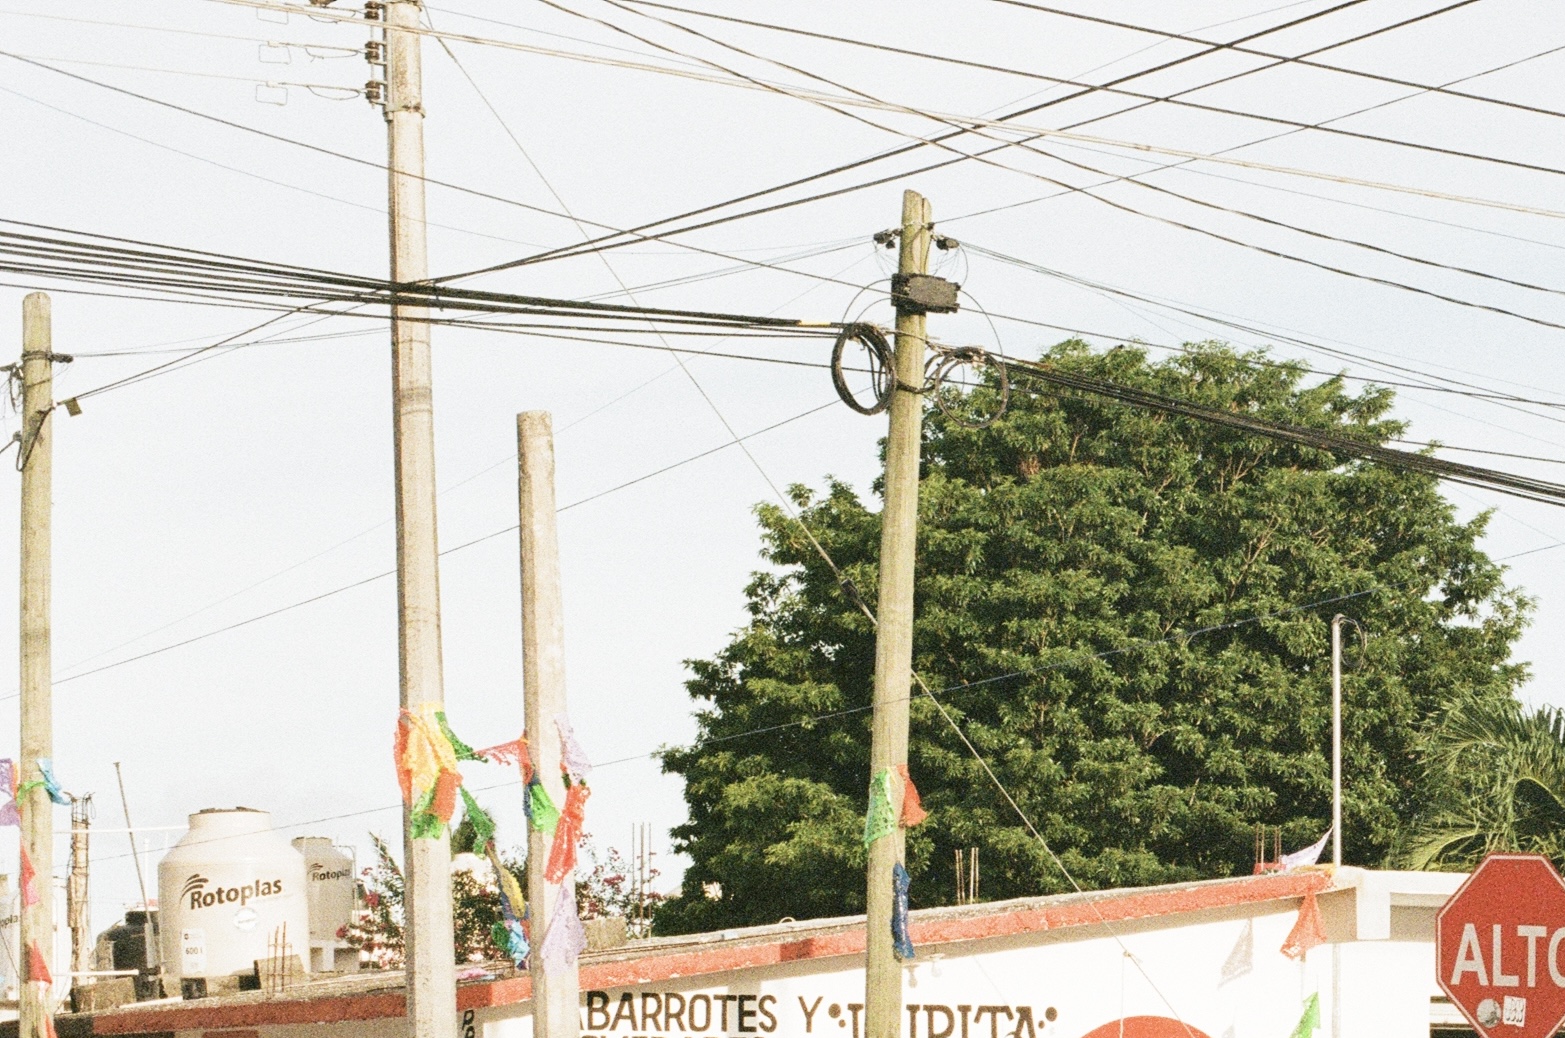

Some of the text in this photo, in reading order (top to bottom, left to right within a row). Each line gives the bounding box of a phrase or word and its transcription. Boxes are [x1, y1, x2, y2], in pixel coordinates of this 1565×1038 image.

[190, 879, 283, 910] Rotoplas
[579, 990, 824, 1033] BARROTES Y
